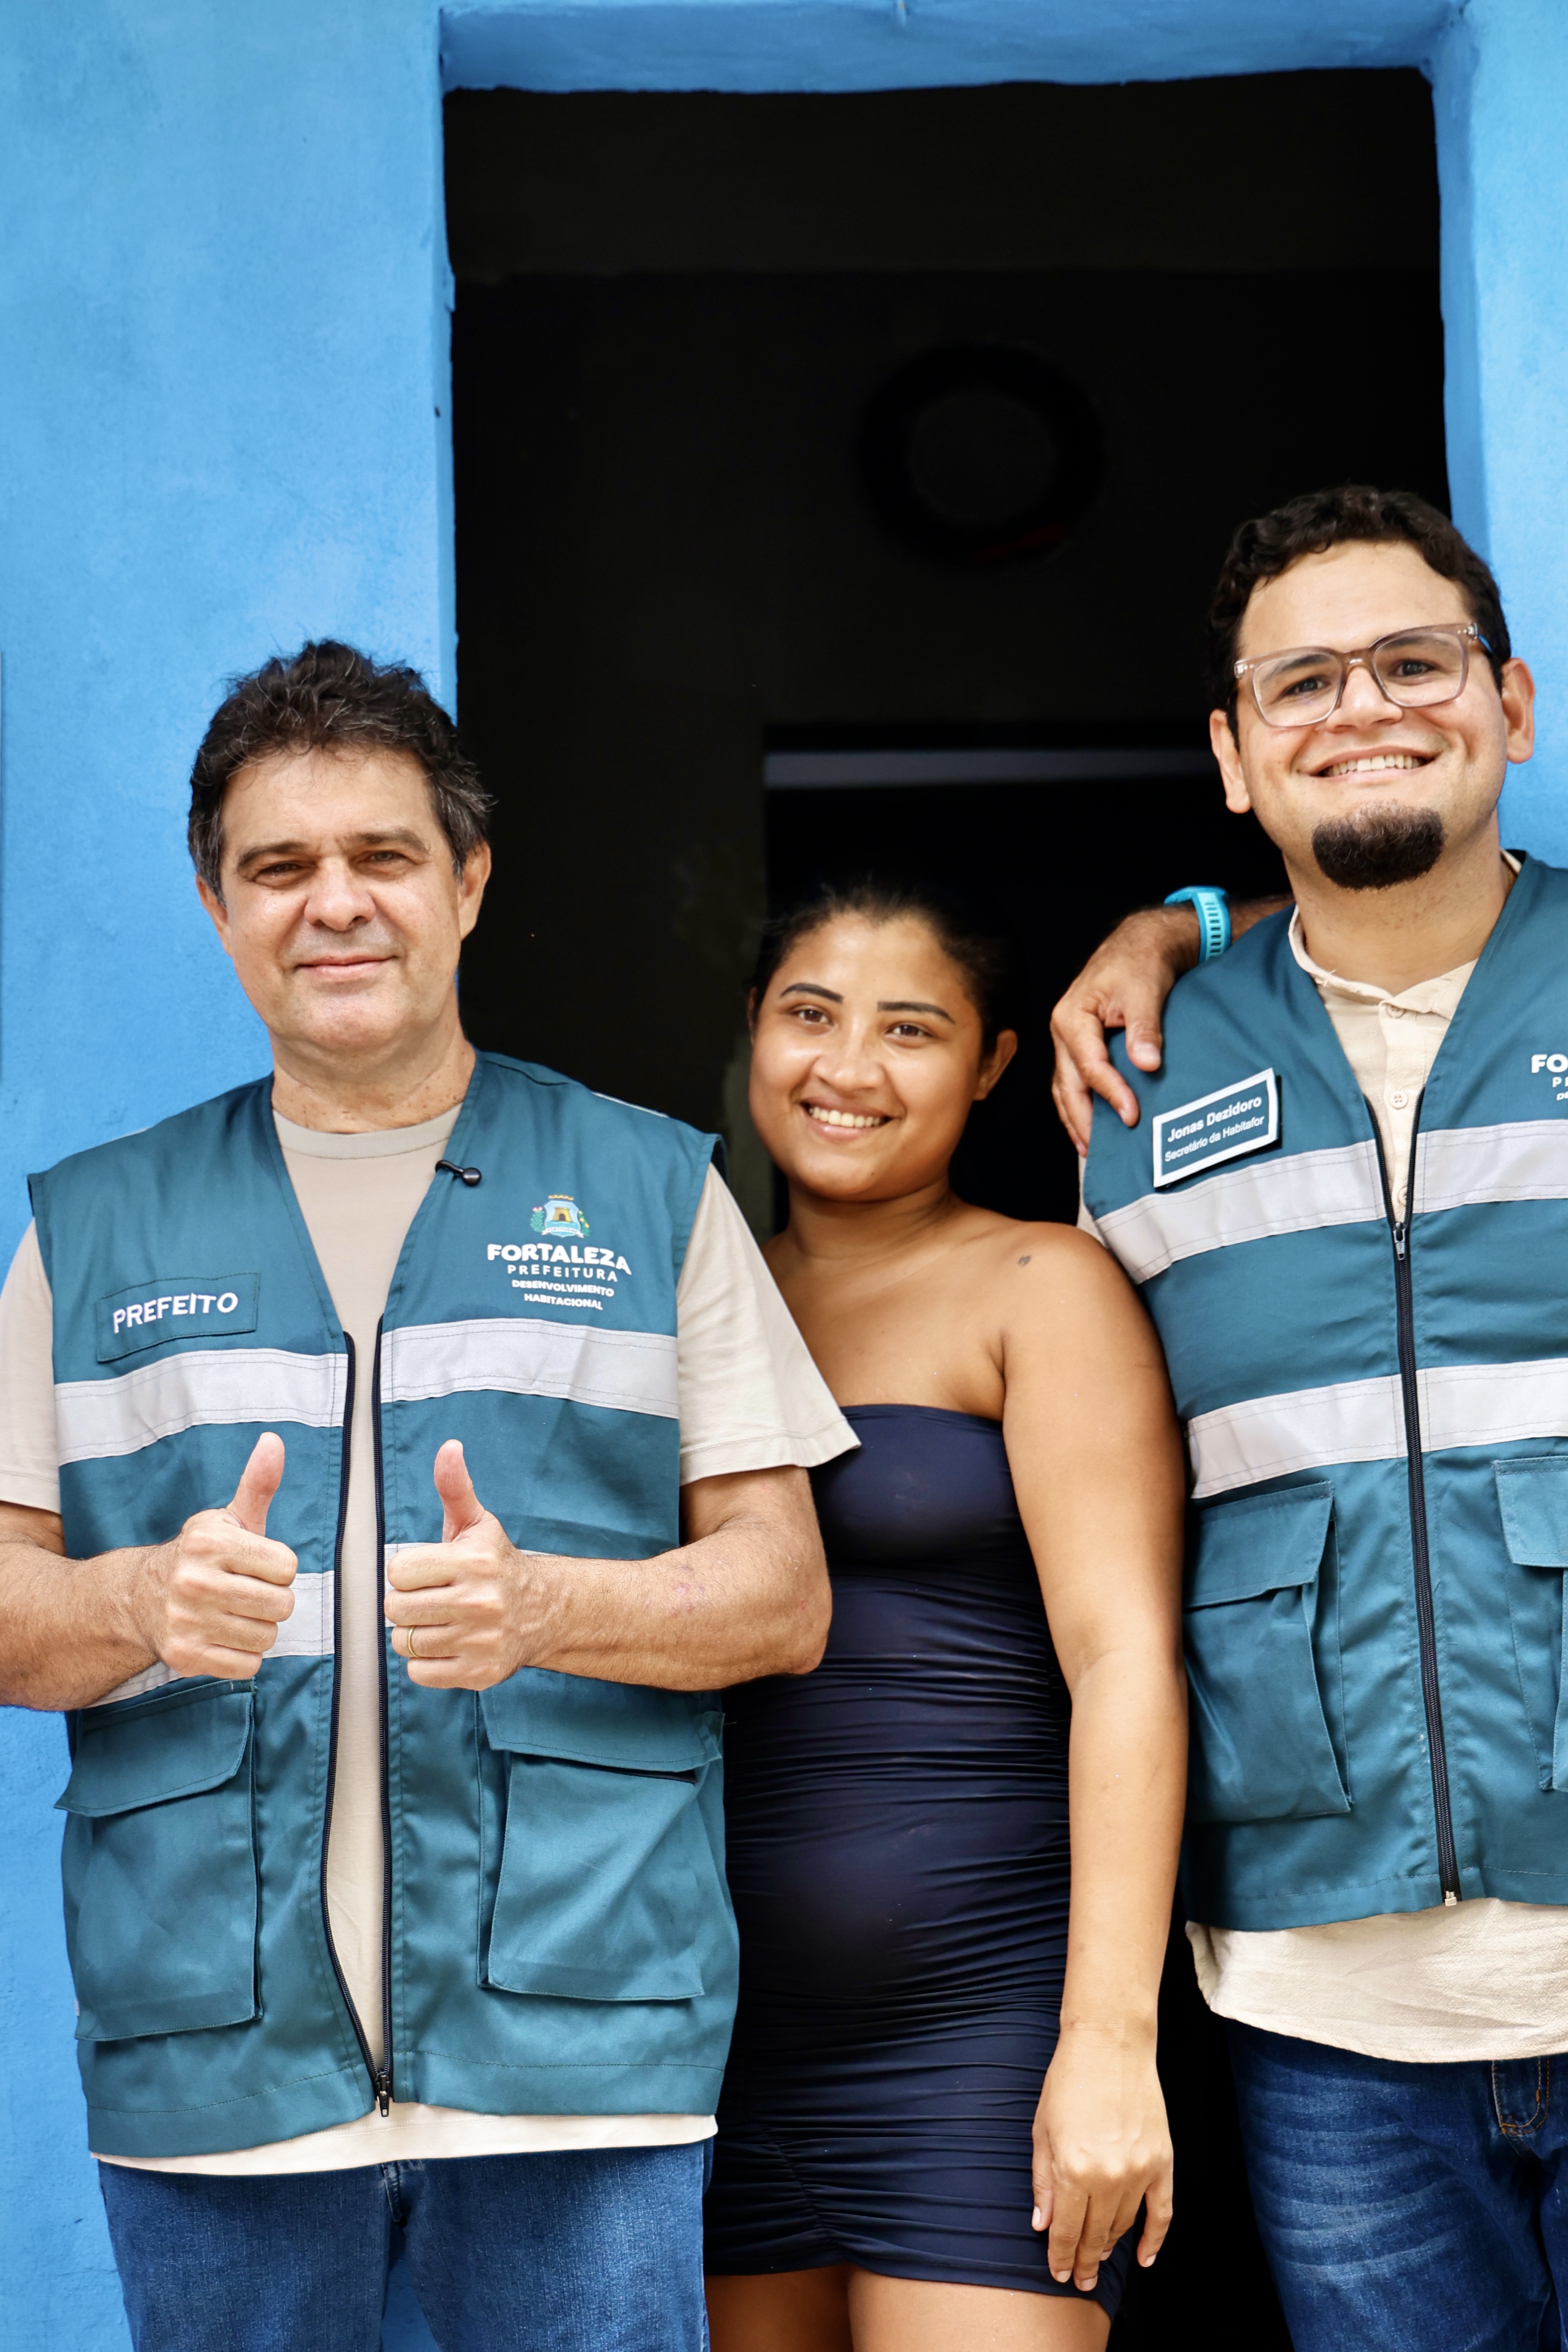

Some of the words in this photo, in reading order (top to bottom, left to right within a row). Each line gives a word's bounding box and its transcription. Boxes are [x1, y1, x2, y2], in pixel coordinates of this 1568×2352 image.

[1531, 1054, 1568, 1073] FO
[1167, 1120, 1204, 1142] Jonas
[1206, 1096, 1262, 1126] Dezidoro
[1164, 1138, 1208, 1162] Secretário
[1209, 1132, 1221, 1143] da
[1222, 1116, 1265, 1138] Habitafor
[487, 1243, 632, 1275] FORTALEZA
[508, 1264, 617, 1282] PREFEITURA
[512, 1280, 614, 1297] DESENVOLVIMENTO
[113, 1292, 238, 1334] PREFEITO
[524, 1293, 603, 1310] HABITACIONAL
